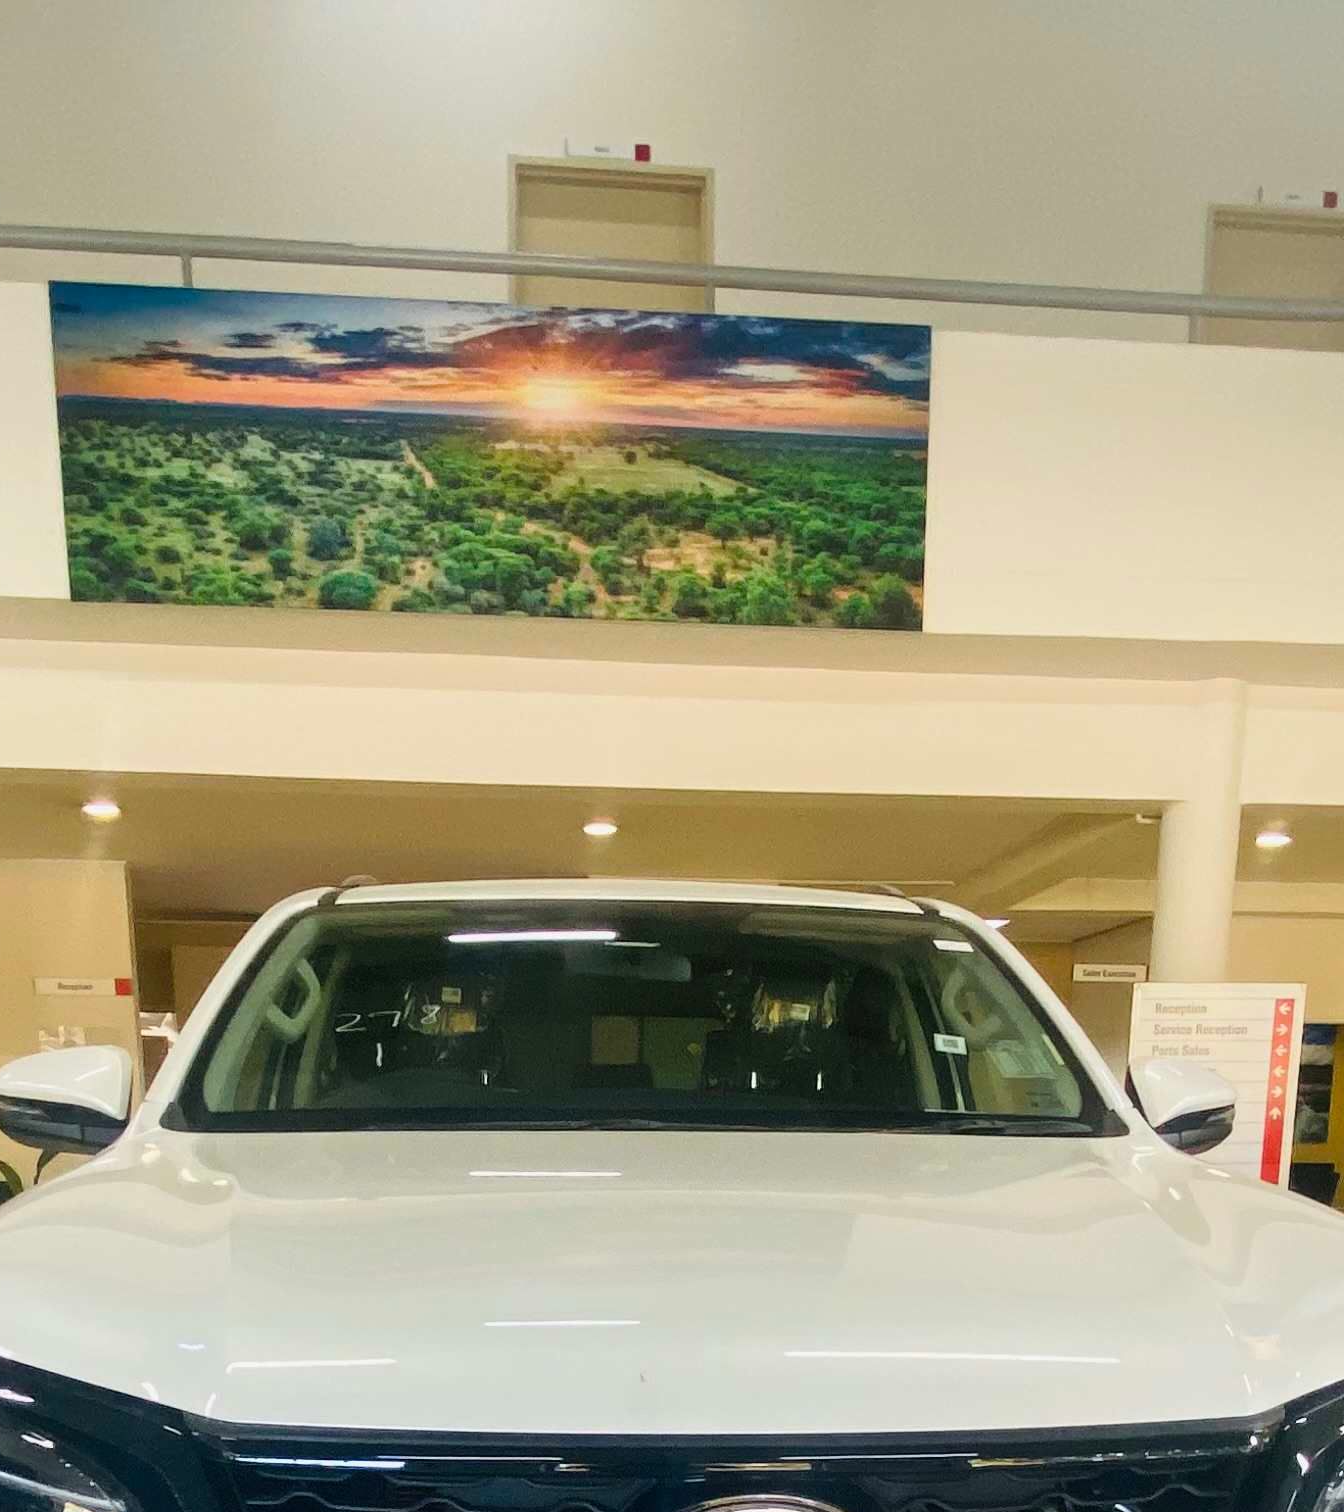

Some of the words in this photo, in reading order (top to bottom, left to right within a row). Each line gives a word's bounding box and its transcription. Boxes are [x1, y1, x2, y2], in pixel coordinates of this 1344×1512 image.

[1155, 1002, 1207, 1016] Reception
[1153, 1024, 1193, 1035] Service
[1195, 1024, 1248, 1036] Reception
[1182, 1045, 1210, 1056] Sales
